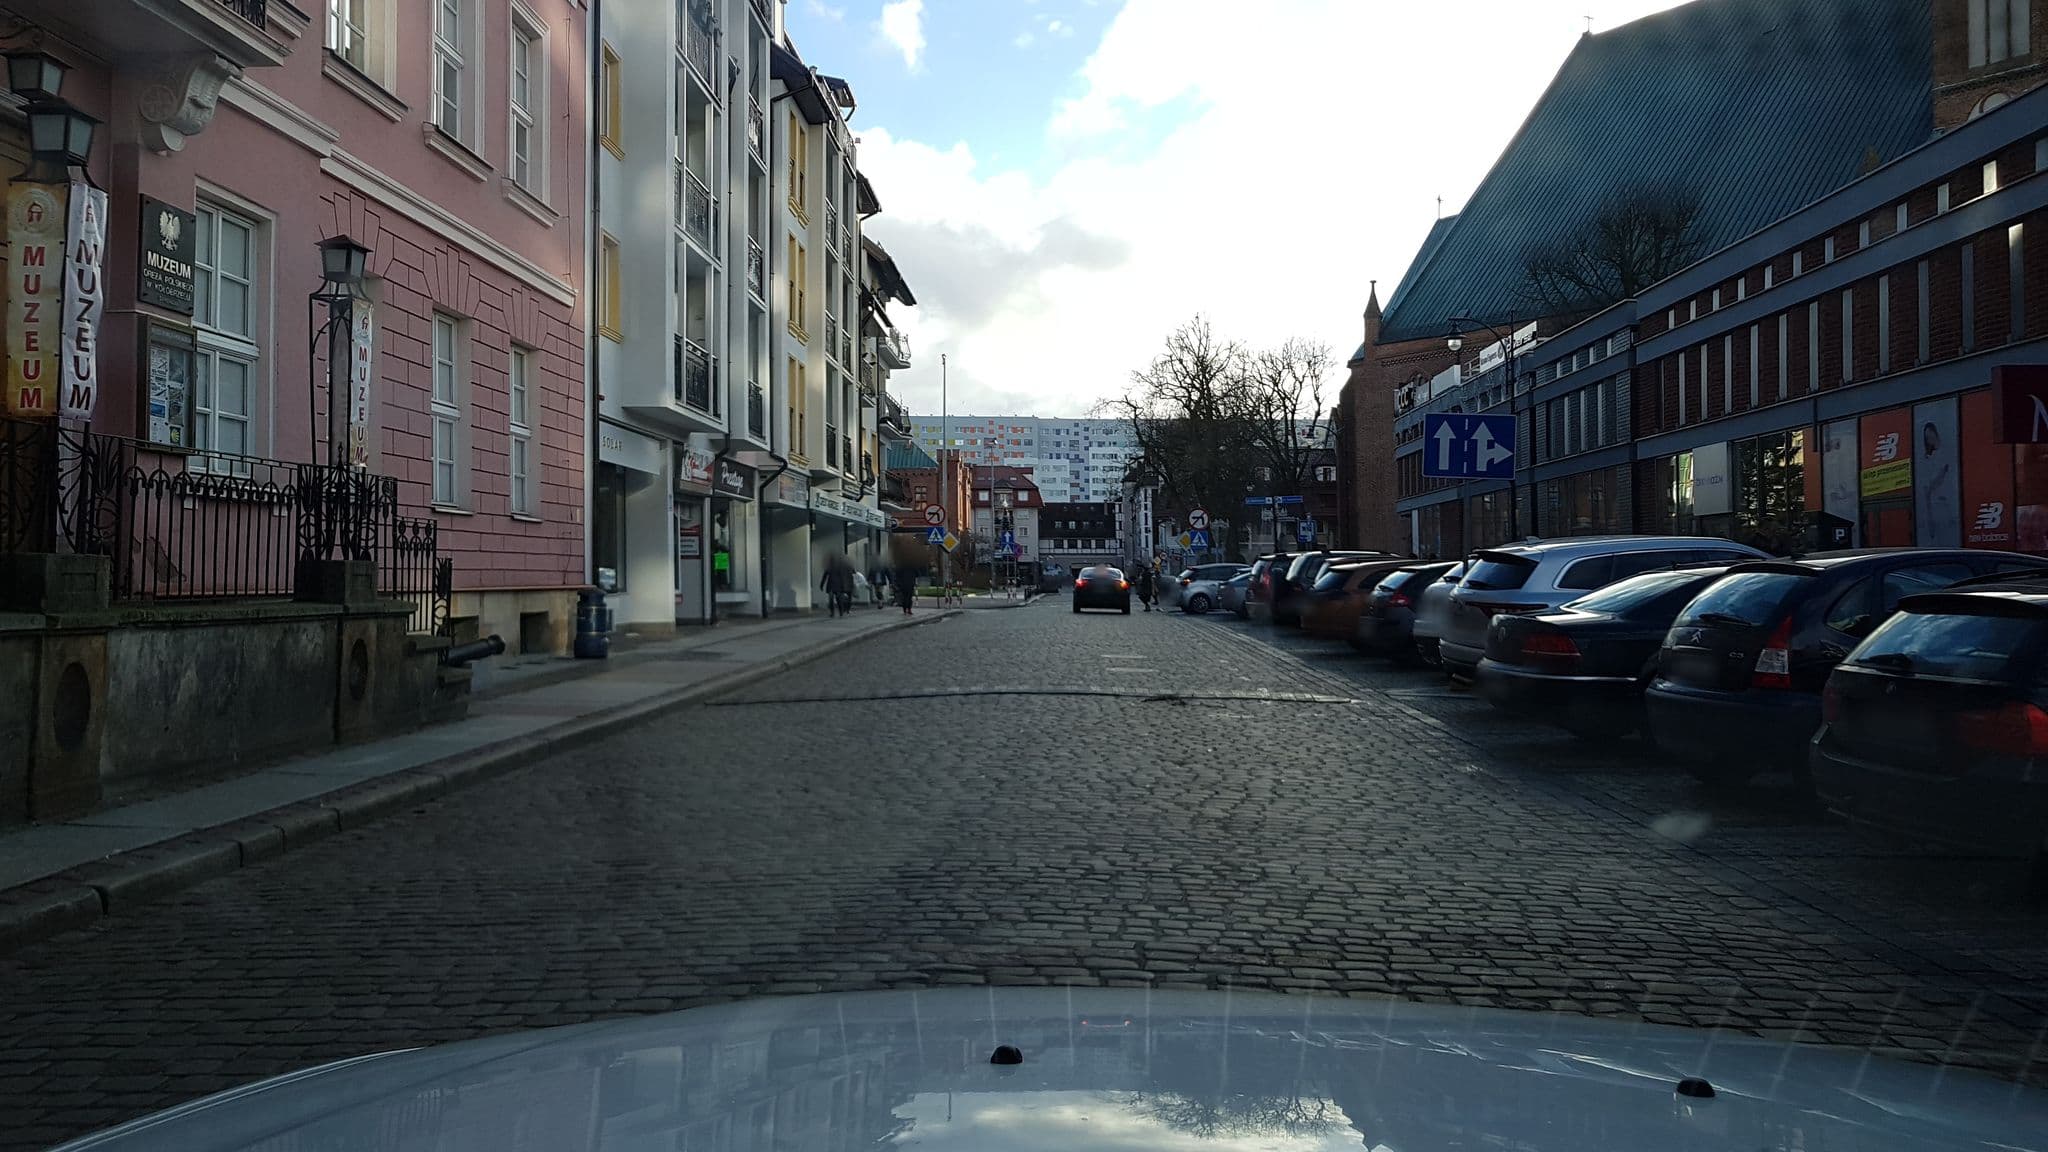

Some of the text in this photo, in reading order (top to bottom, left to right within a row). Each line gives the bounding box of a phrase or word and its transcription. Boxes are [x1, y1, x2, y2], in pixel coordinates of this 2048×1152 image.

[20, 245, 46, 410] MUZEUM
[69, 239, 98, 412] MUZEUM
[147, 251, 191, 280] MUZEUM
[354, 346, 368, 462] MUZEUM
